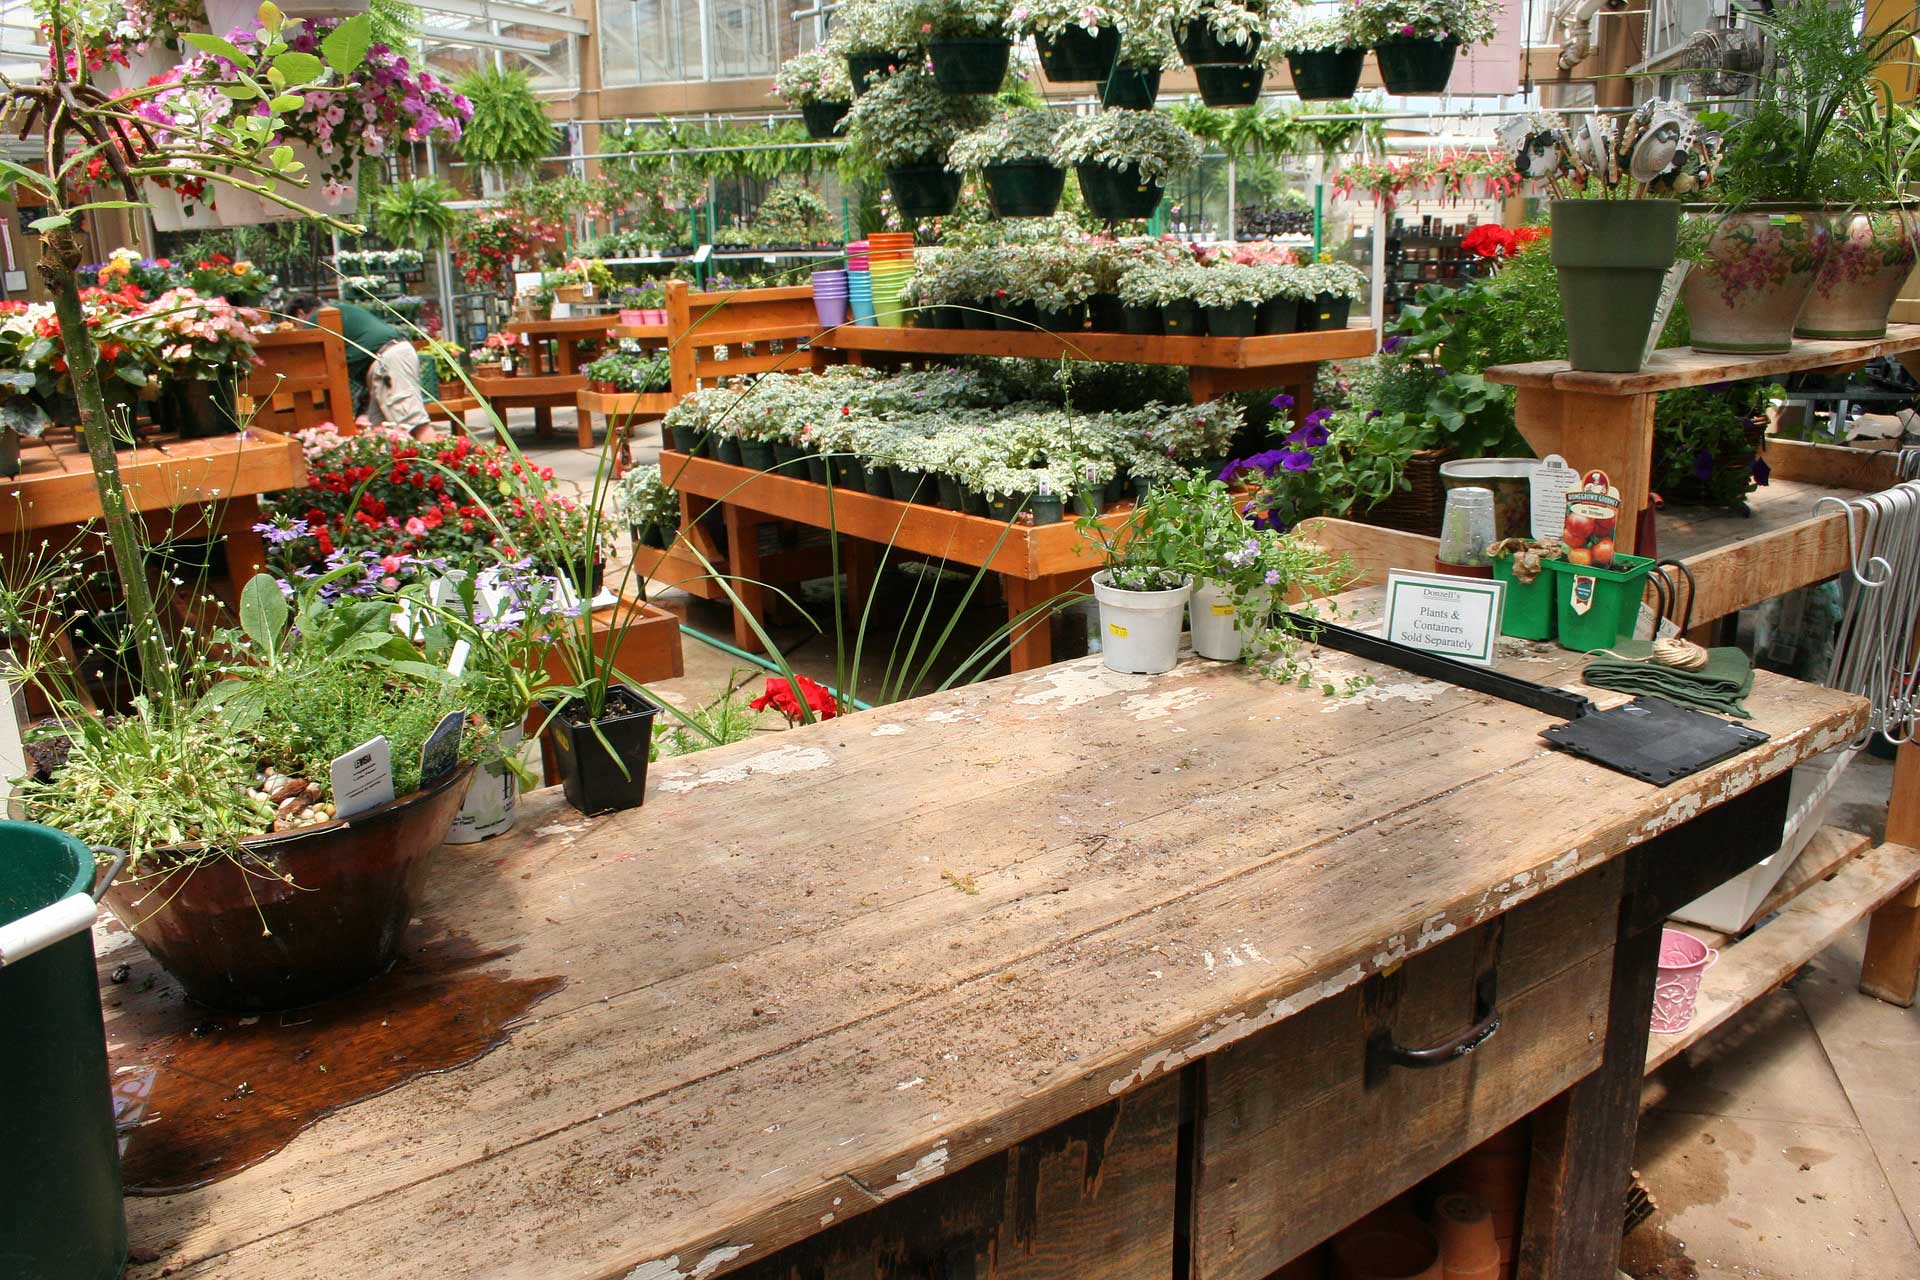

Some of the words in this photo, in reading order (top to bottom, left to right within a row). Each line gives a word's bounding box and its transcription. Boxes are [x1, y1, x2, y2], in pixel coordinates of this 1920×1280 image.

[1423, 589, 1460, 599] Donzell's
[1420, 607, 1448, 619] Plants
[1451, 610, 1460, 620] &
[1413, 619, 1464, 634] Containers
[1401, 631, 1422, 643] Sold
[1424, 634, 1473, 650] Separately
